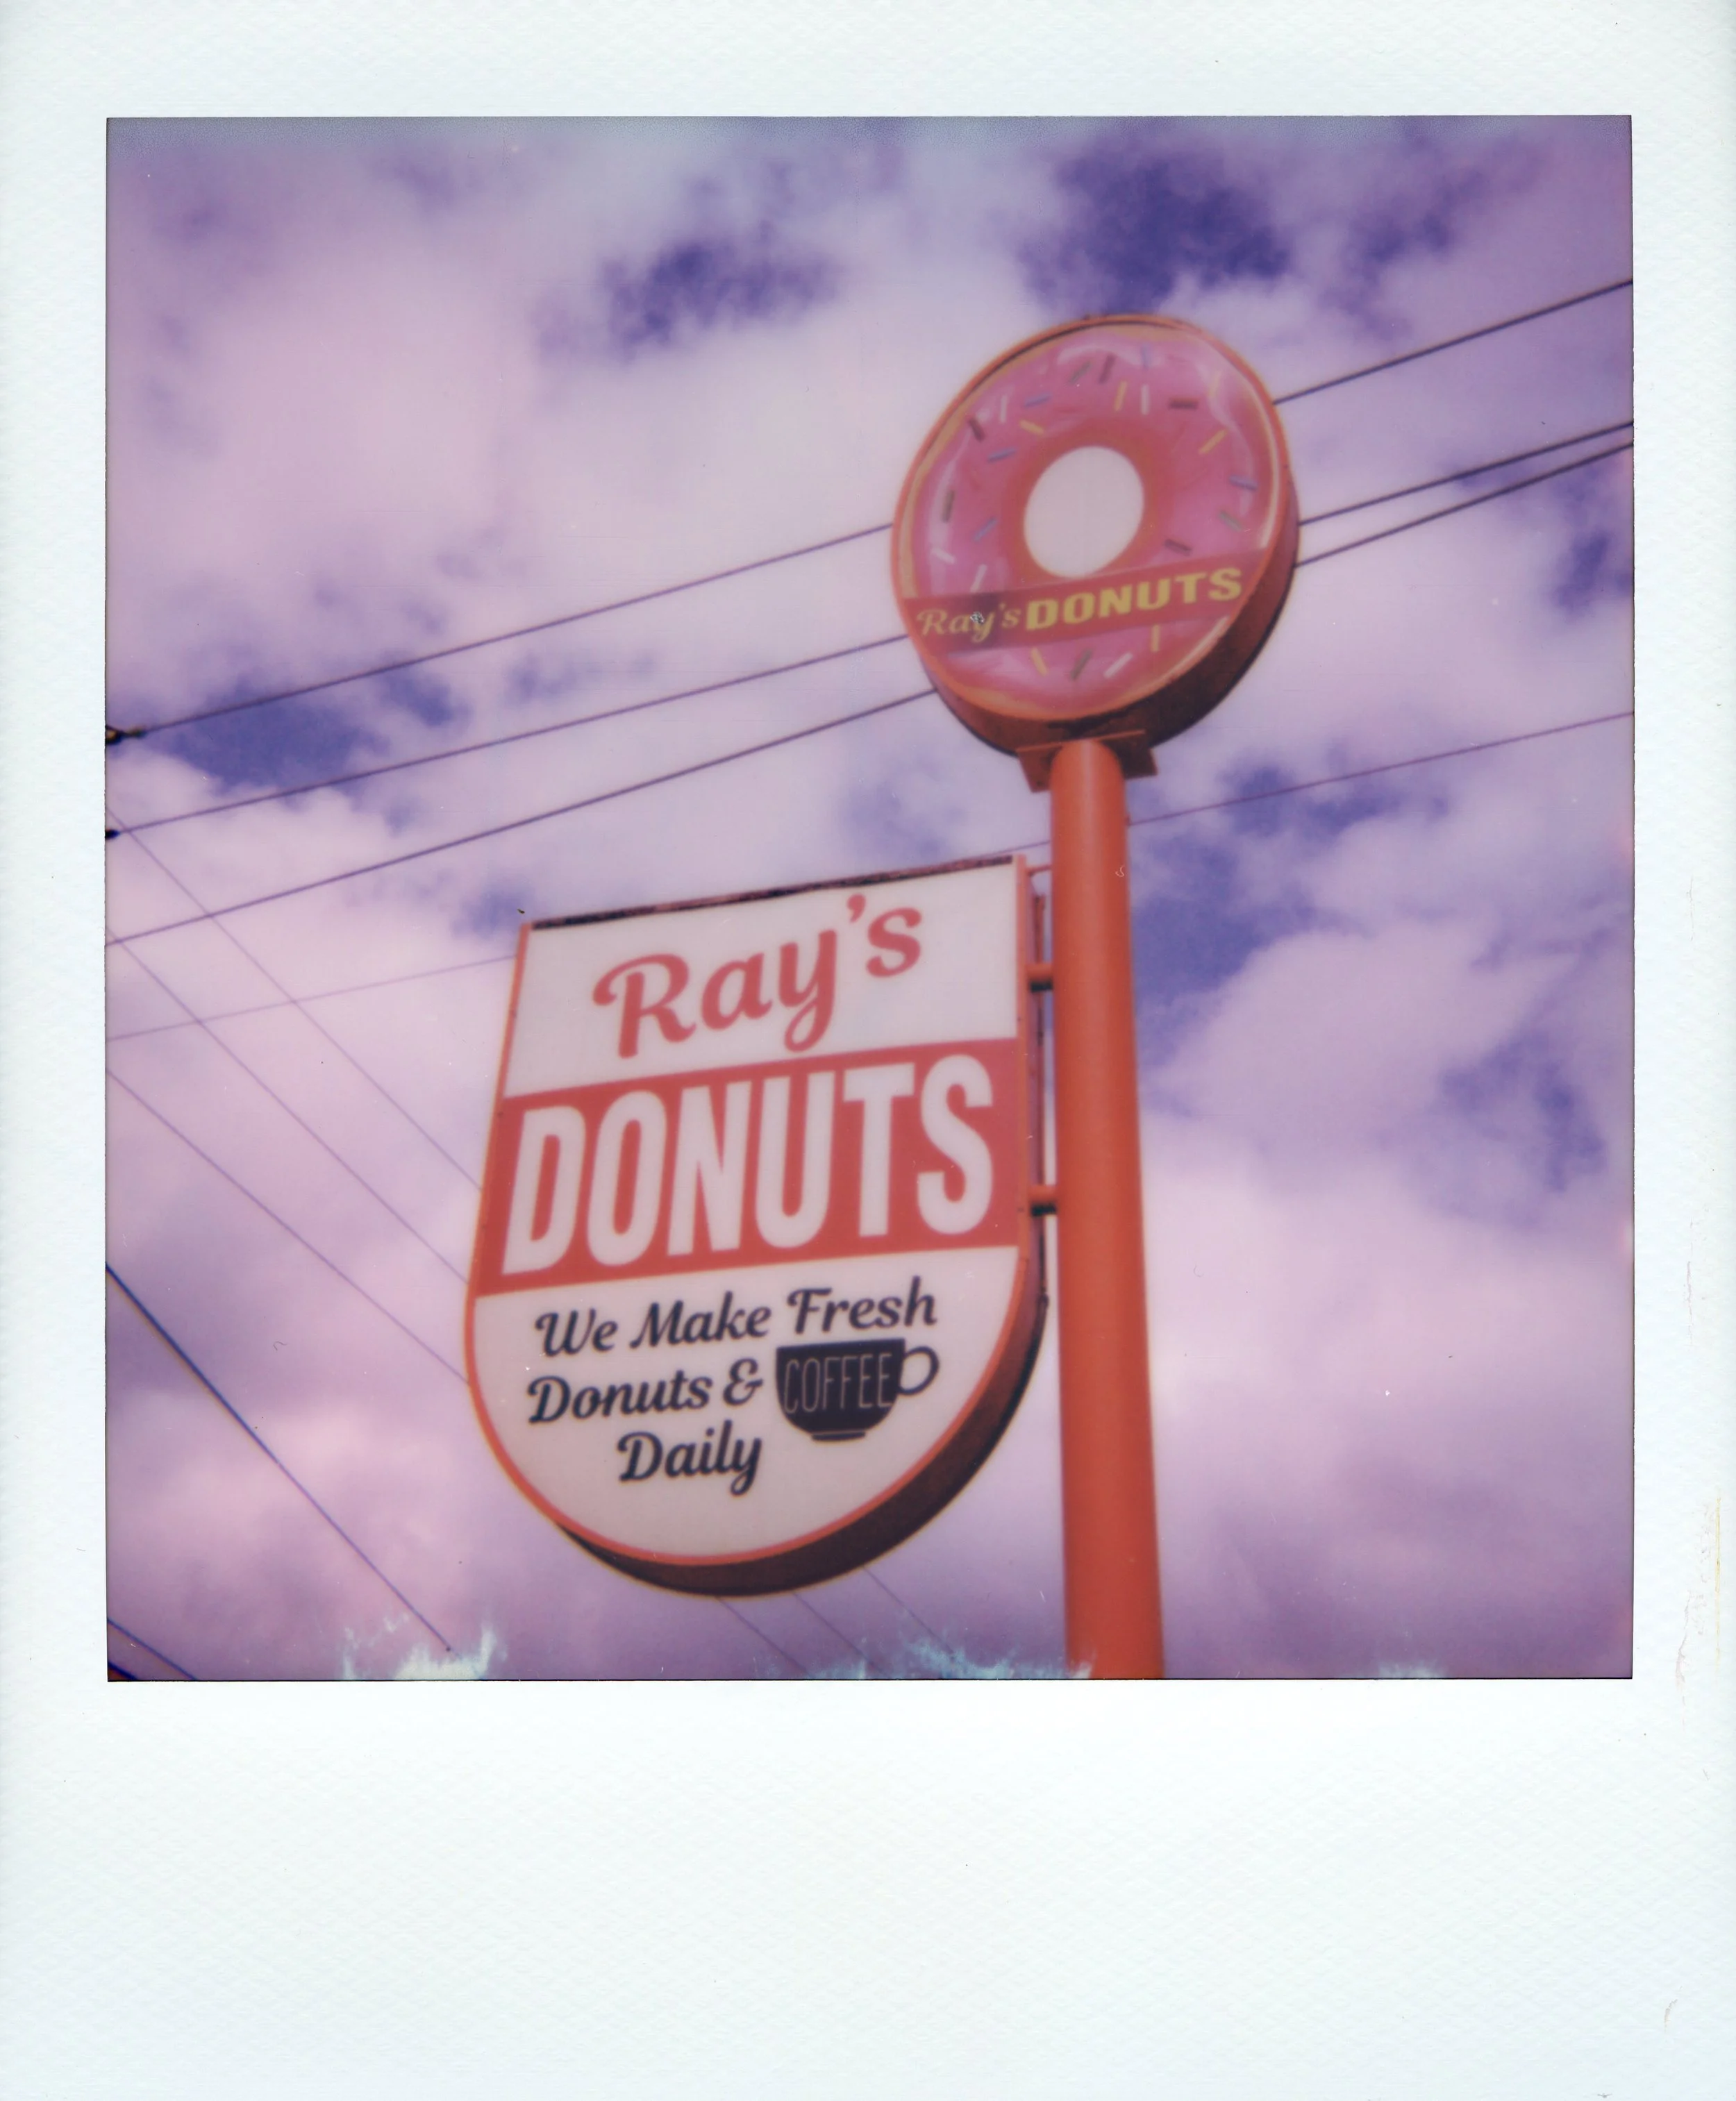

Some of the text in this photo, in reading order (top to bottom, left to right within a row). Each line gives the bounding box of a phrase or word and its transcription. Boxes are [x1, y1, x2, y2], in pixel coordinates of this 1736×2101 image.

[917, 567, 1242, 642] Ray's DONUTS
[592, 893, 922, 1059] Ray's
[501, 1054, 994, 1276] DONUTS
[534, 1275, 937, 1357] We Make Fresh
[528, 1353, 893, 1423] Donuts & COFFEE
[617, 1419, 762, 1496] Daily
